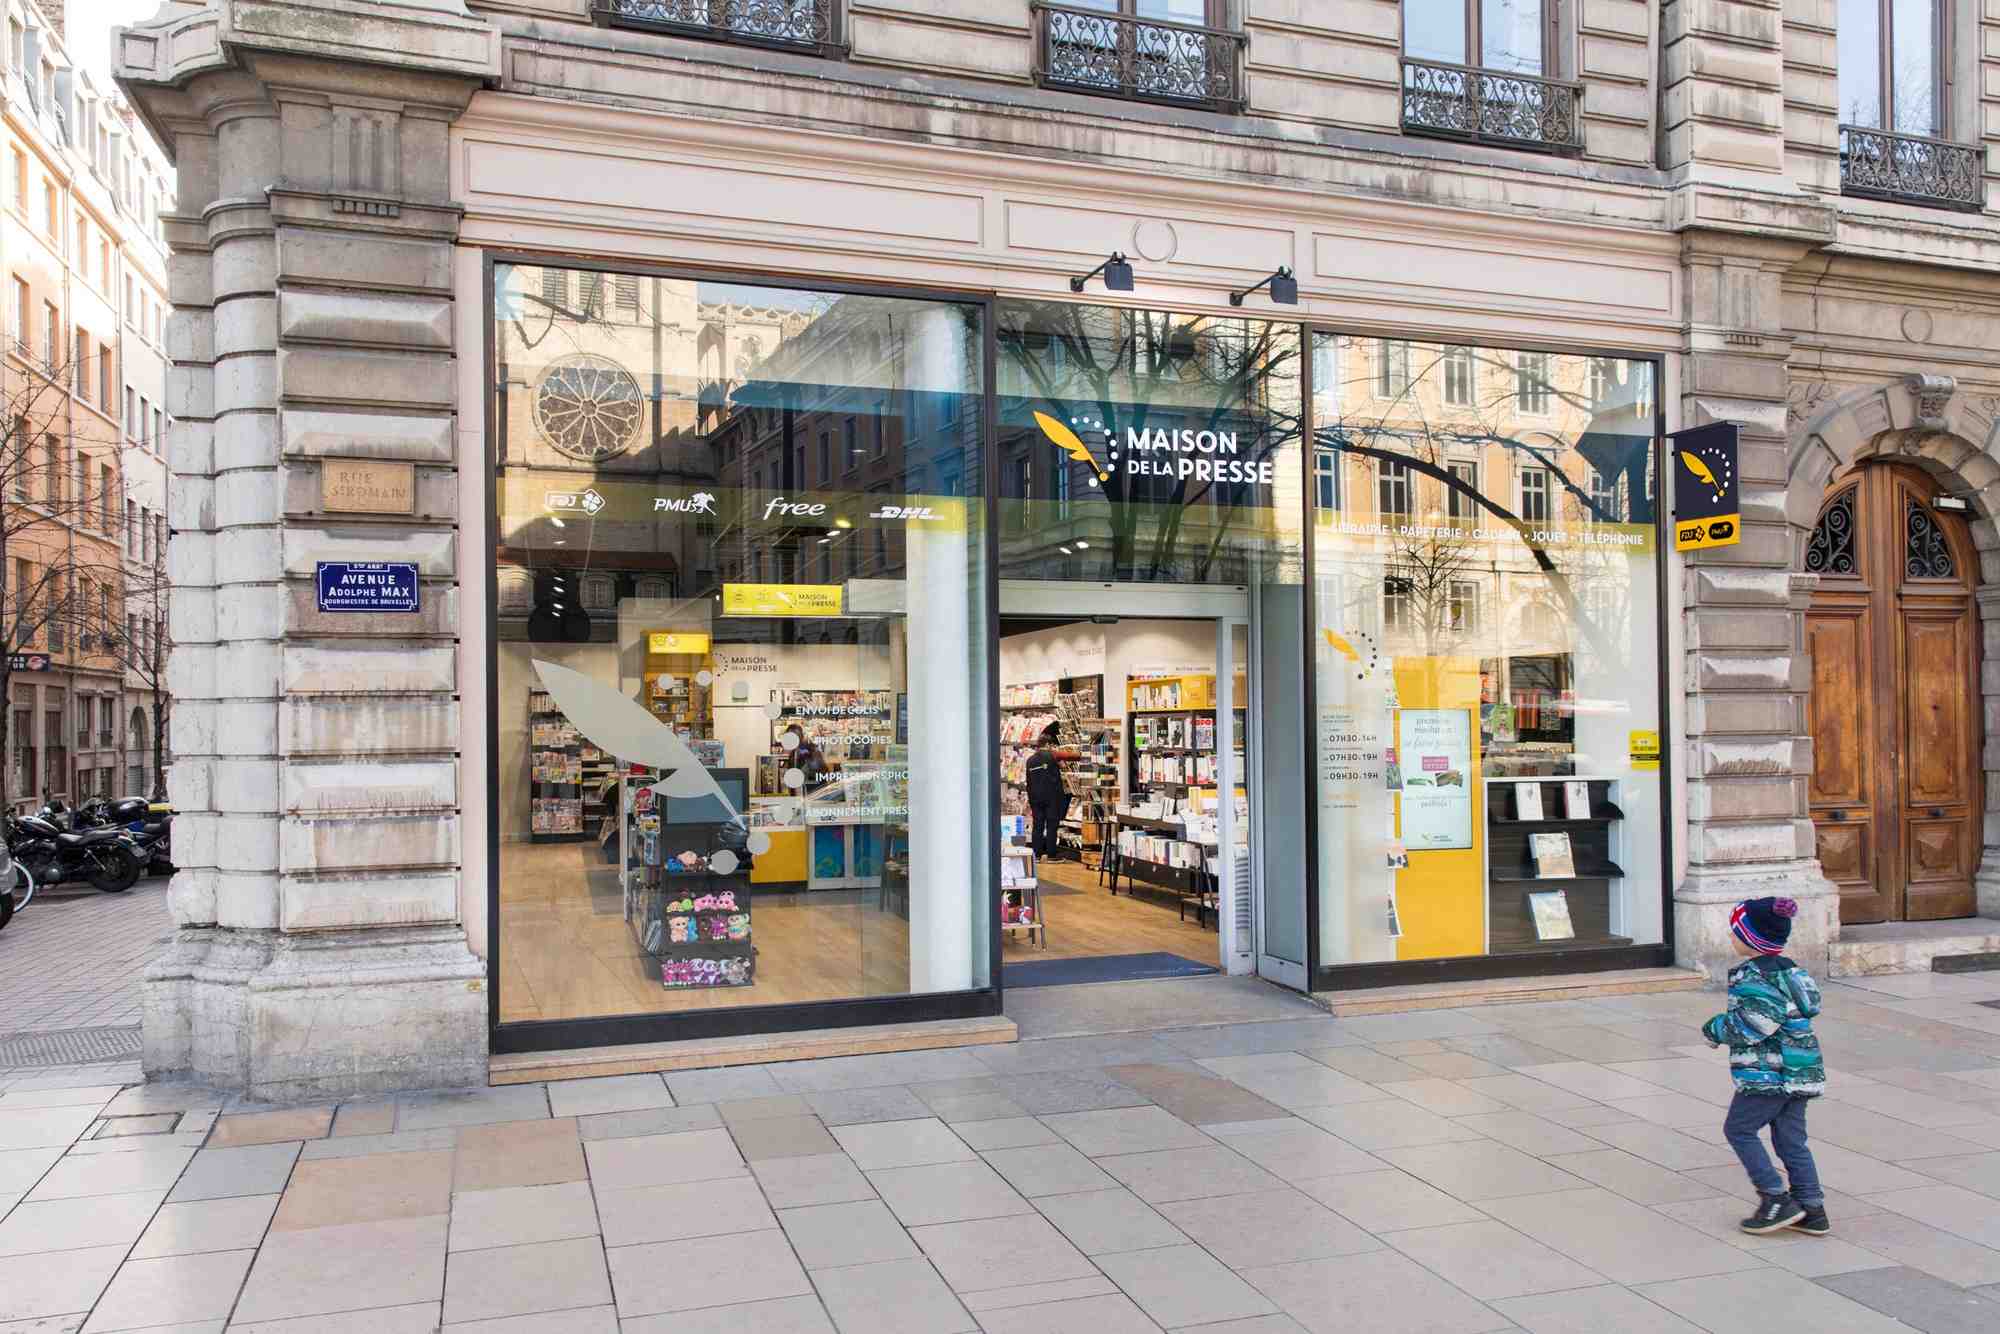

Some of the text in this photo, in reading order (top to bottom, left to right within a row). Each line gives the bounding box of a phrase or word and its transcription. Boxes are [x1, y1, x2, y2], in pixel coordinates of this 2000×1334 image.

[1127, 426, 1238, 455] MAISON
[1127, 458, 1273, 484] DE LA PRESSE
[654, 497, 692, 513] PMU
[762, 497, 827, 521] free
[1400, 526, 1463, 538] PAPETERIE
[341, 574, 396, 585] AVENUE
[381, 586, 410, 597] MAX
[730, 656, 768, 665] MAISON
[747, 664, 778, 673] PRESSE
[795, 705, 831, 716] ENVOI
[832, 705, 846, 716] DE
[815, 735, 893, 746] PHOTOCOPIES
[815, 770, 888, 782] IMPRESNS
